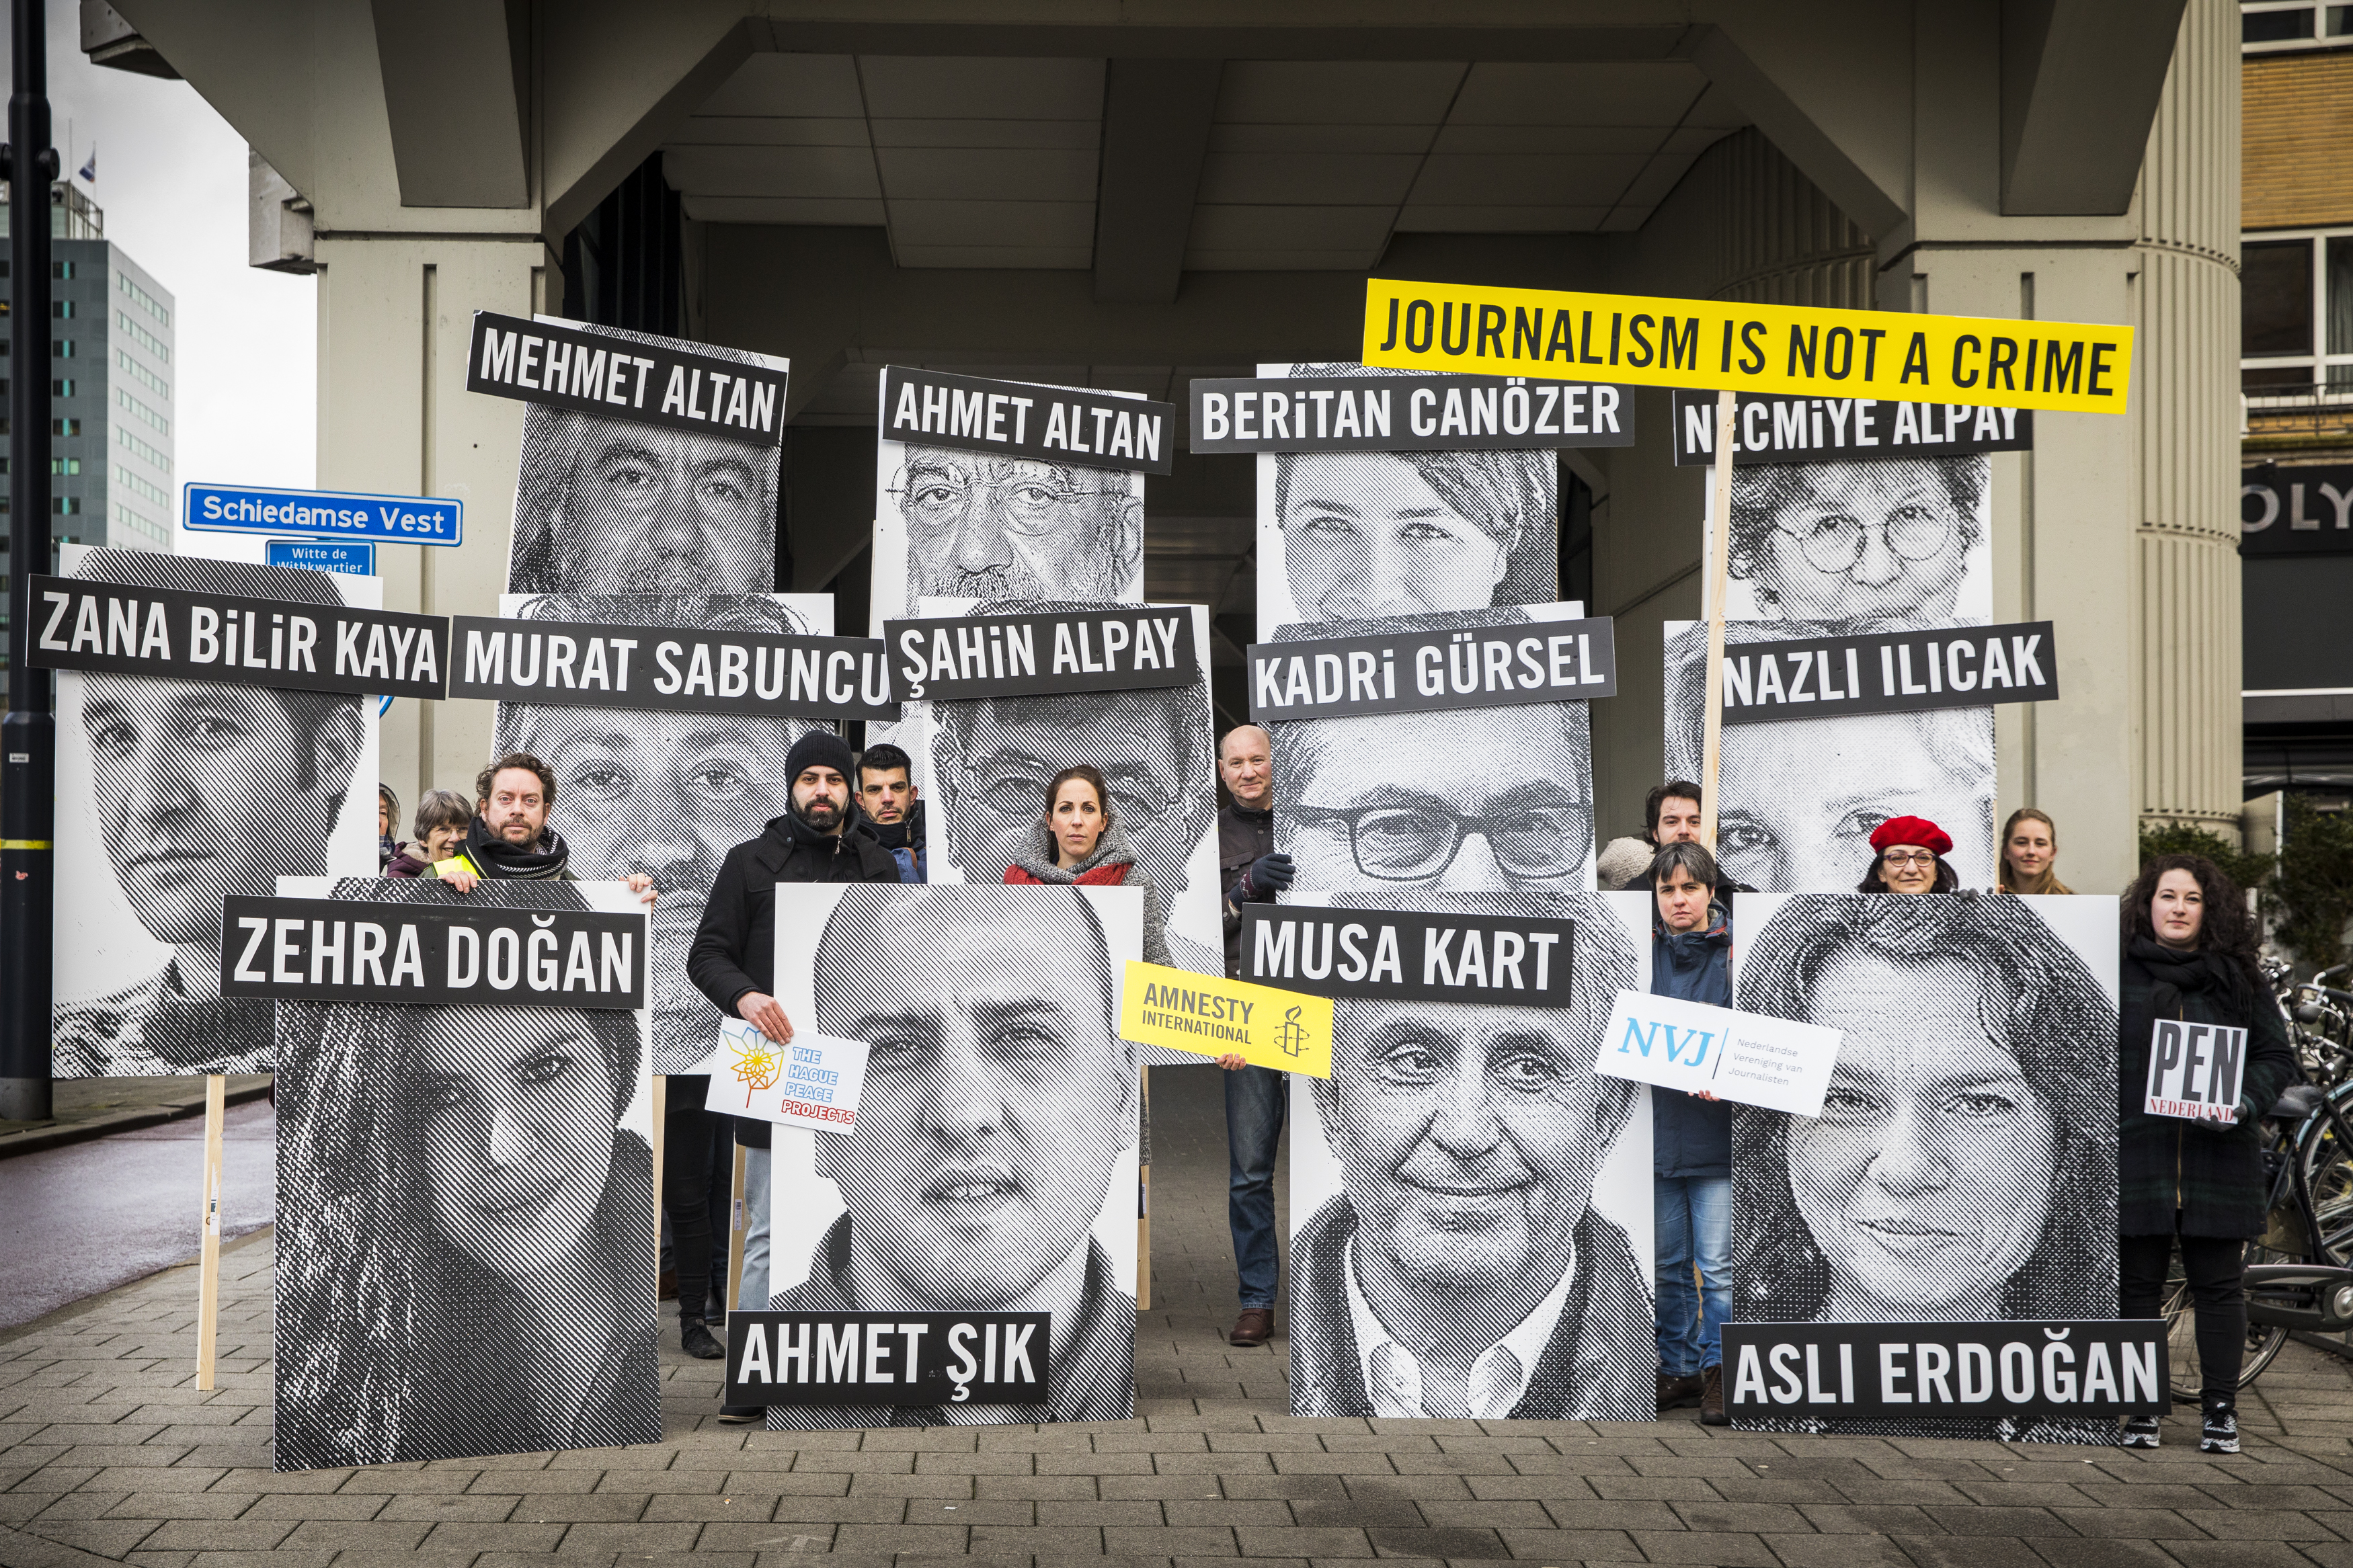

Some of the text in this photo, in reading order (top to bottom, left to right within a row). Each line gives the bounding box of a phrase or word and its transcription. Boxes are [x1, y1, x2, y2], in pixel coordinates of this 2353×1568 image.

[1380, 298, 2116, 396] JOURNALISM IS NOT A CRIME
[481, 328, 776, 431] MEHMET ALTAN
[893, 382, 1161, 461] AHMET ALTAN
[1411, 378, 1620, 436] CANÖZER
[1893, 401, 2018, 444] ALPAY
[203, 495, 444, 533] Schiedamse Vest
[292, 548, 348, 560] Witte de
[40, 591, 171, 660] ZANA
[335, 622, 438, 683] KAYA
[1053, 618, 1179, 673] ALPAY
[465, 630, 889, 706] MURAT SABUNCU
[1416, 633, 1605, 696] GÜRSEL
[1723, 635, 2046, 707] NAZLI ILICAK
[235, 915, 631, 993] ZEHRA DOĞAN
[1254, 920, 1558, 990] MUSA KART
[1142, 1010, 1252, 1044] INTERNATIONAL
[1144, 983, 1254, 1024] AMNESTY
[793, 1046, 822, 1065] THE
[1618, 1017, 1715, 1067] NVJ
[1734, 1053, 1802, 1073] Vereniging van
[1737, 1038, 1798, 1057] Nederlandse
[2152, 1022, 2241, 1106] PEN
[785, 1082, 834, 1103] PEACE
[789, 1065, 838, 1085] HAGUE
[1728, 1067, 1789, 1085] Journalisten
[781, 1100, 855, 1125] PROJECTS
[2149, 1098, 2234, 1122] NEDERLAND
[737, 1323, 1036, 1401] AHMET ŞIK
[1733, 1327, 2159, 1403] ASLI ERDOĞAN
